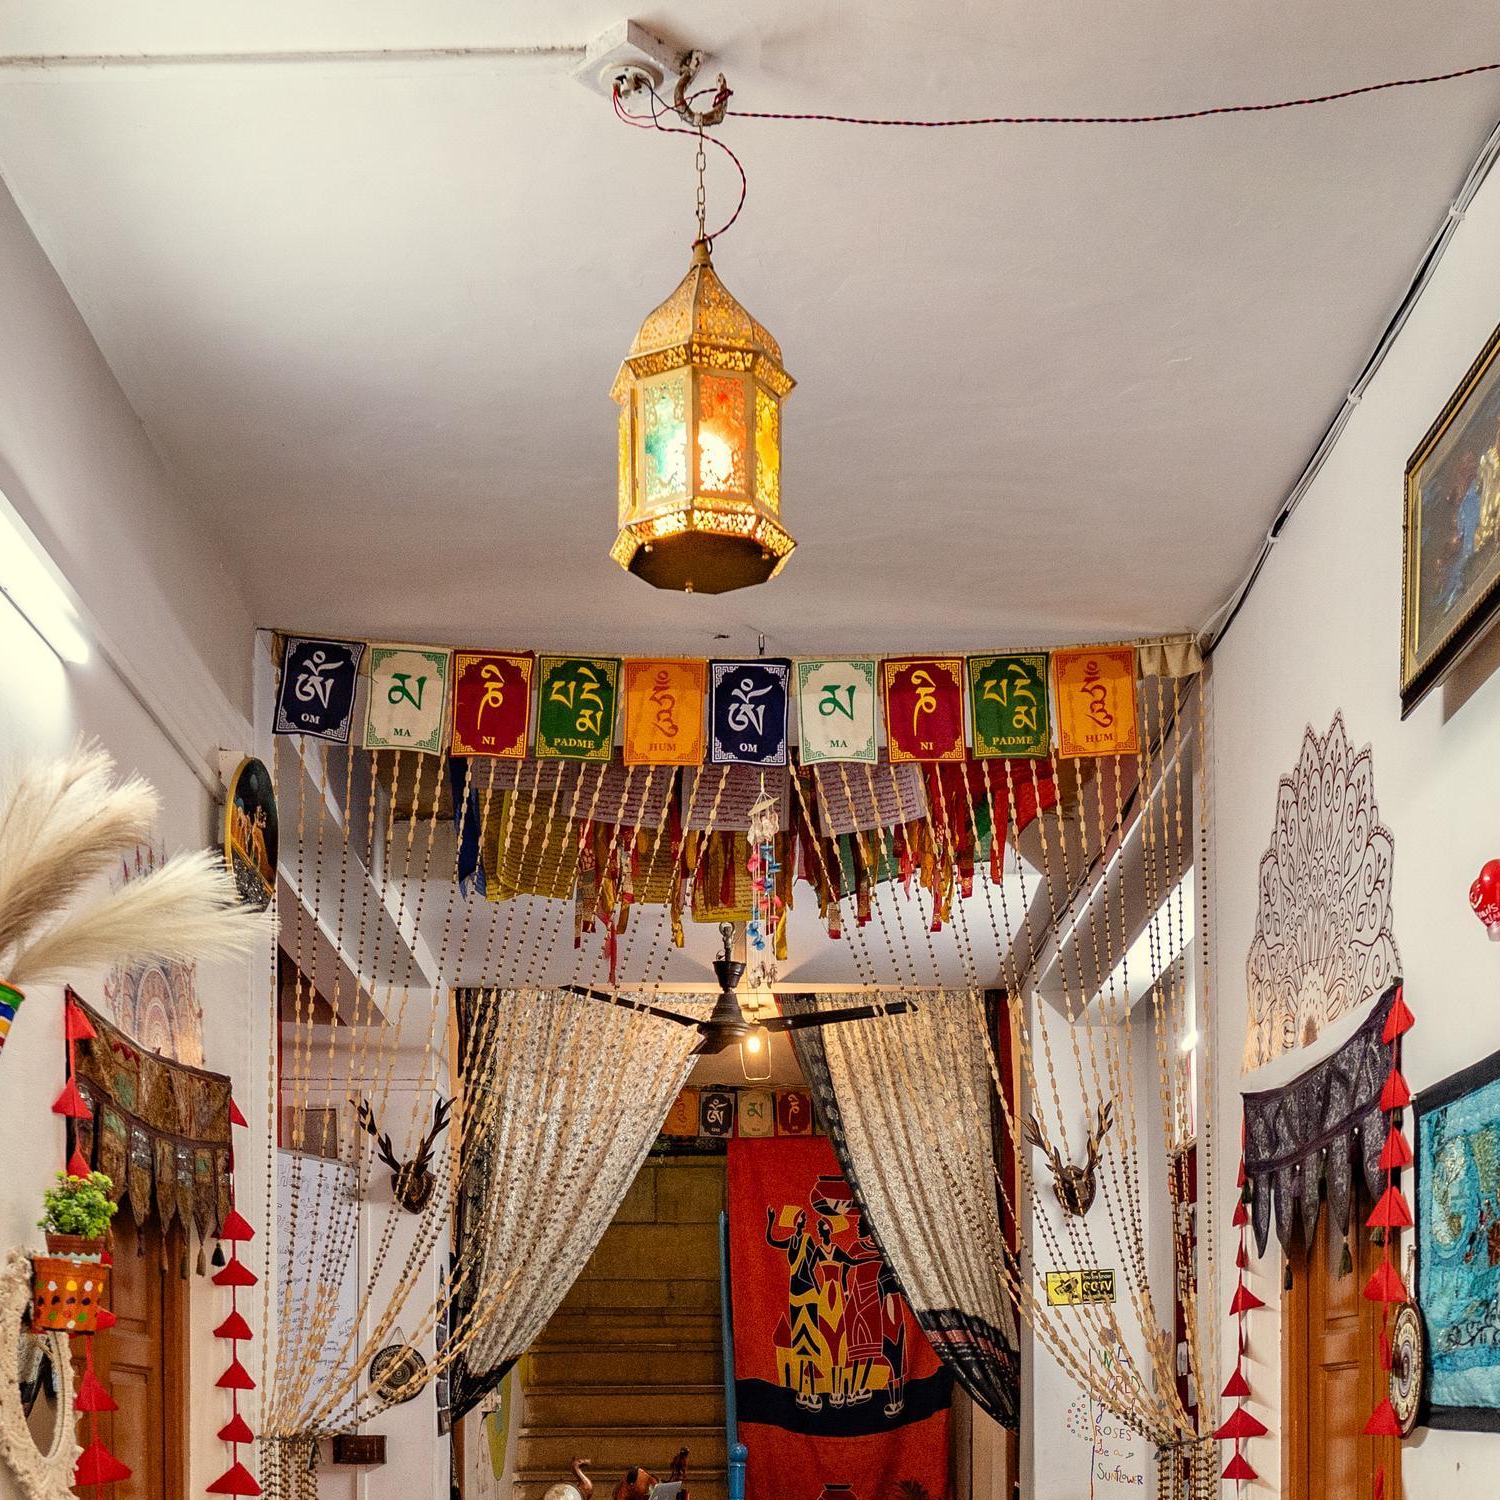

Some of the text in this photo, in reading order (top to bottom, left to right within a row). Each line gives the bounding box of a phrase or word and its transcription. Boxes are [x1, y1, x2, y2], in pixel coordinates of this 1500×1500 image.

[301, 713, 320, 724] OM
[393, 728, 412, 737] MA
[482, 736, 496, 745] NI
[553, 738, 595, 748] PADME
[992, 736, 1034, 746] PADME
[1085, 733, 1114, 743] HUM
[650, 743, 677, 752] HUM
[739, 743, 758, 753] OM
[830, 740, 848, 748] MA
[920, 742, 934, 750] NI
[1082, 1280, 1112, 1293] CCTV
[1094, 1425, 1132, 1441] ROSES
